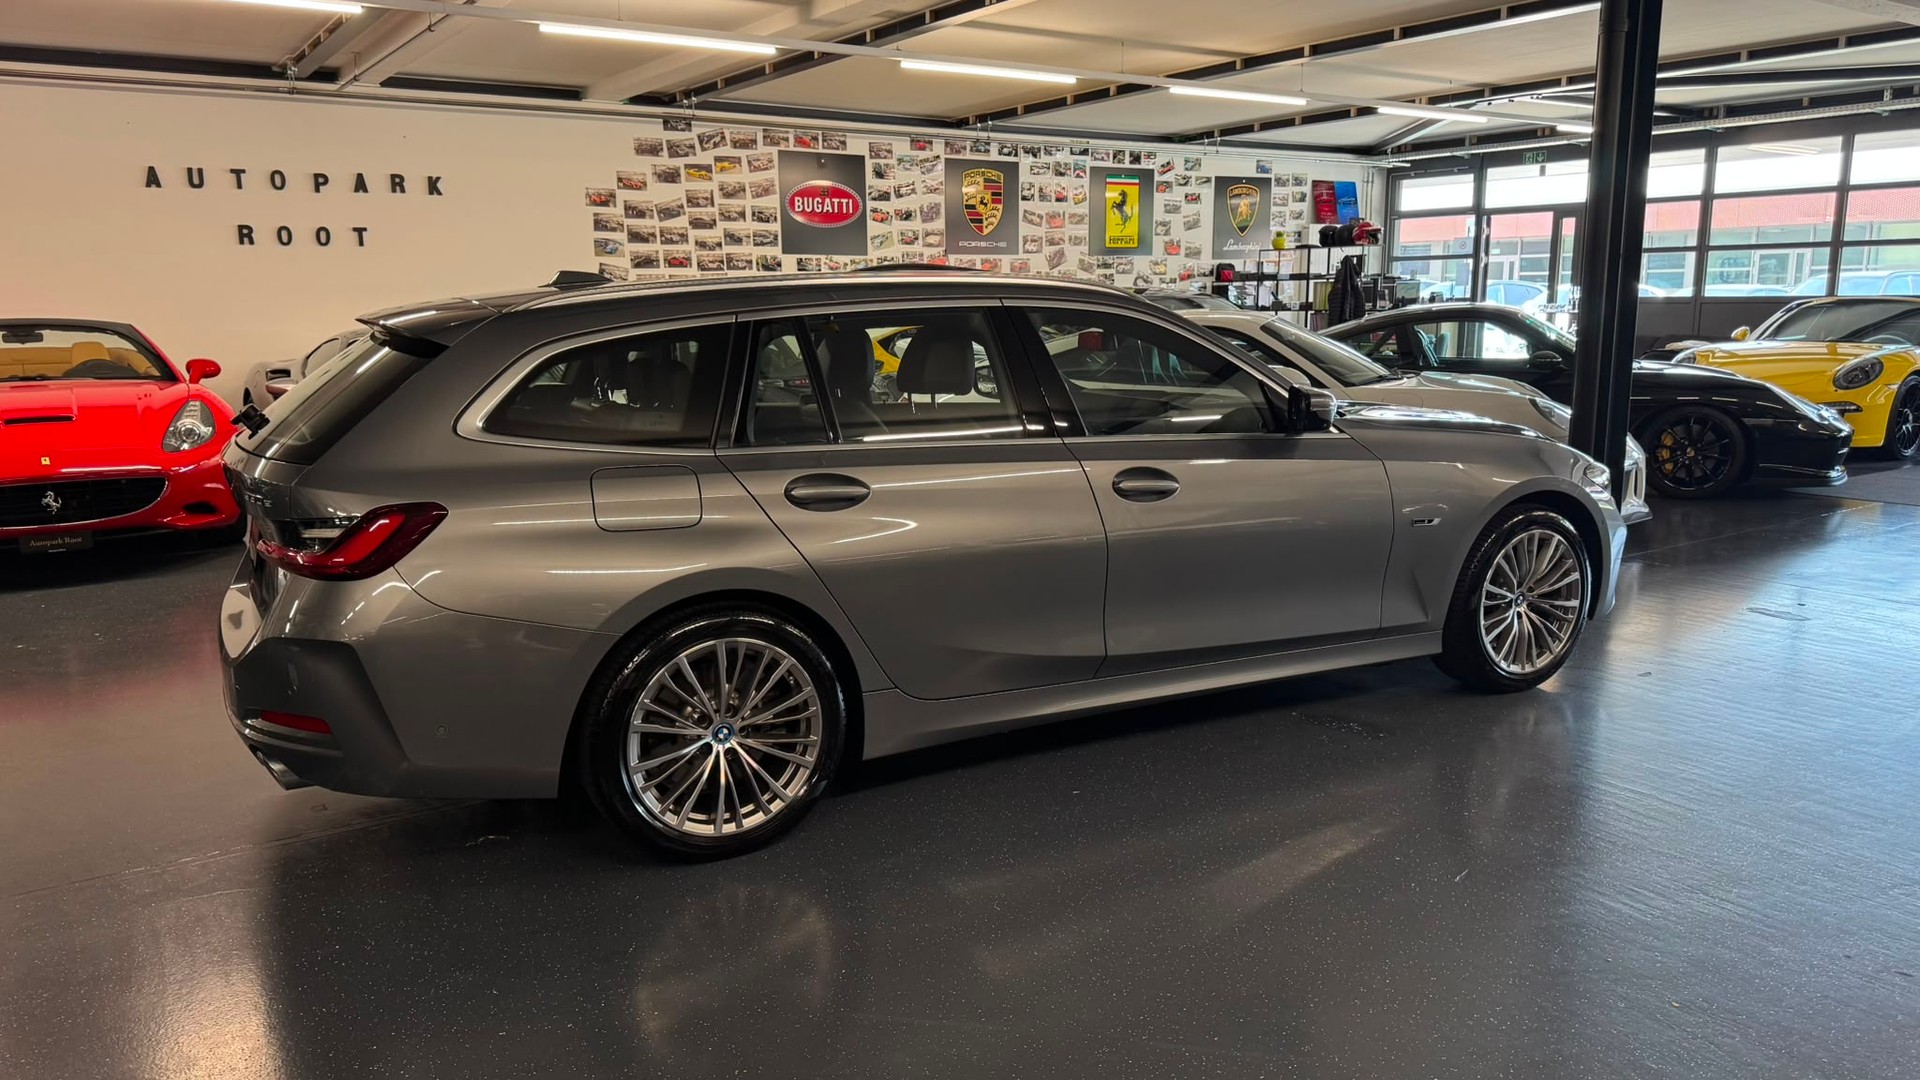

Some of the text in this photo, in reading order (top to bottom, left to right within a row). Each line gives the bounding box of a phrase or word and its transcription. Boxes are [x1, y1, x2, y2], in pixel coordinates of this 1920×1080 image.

[145, 165, 443, 196] AUTOPARK
[794, 196, 853, 214] BUGATTI
[237, 224, 367, 247] ROOT
[1109, 235, 1135, 245] Ferrari
